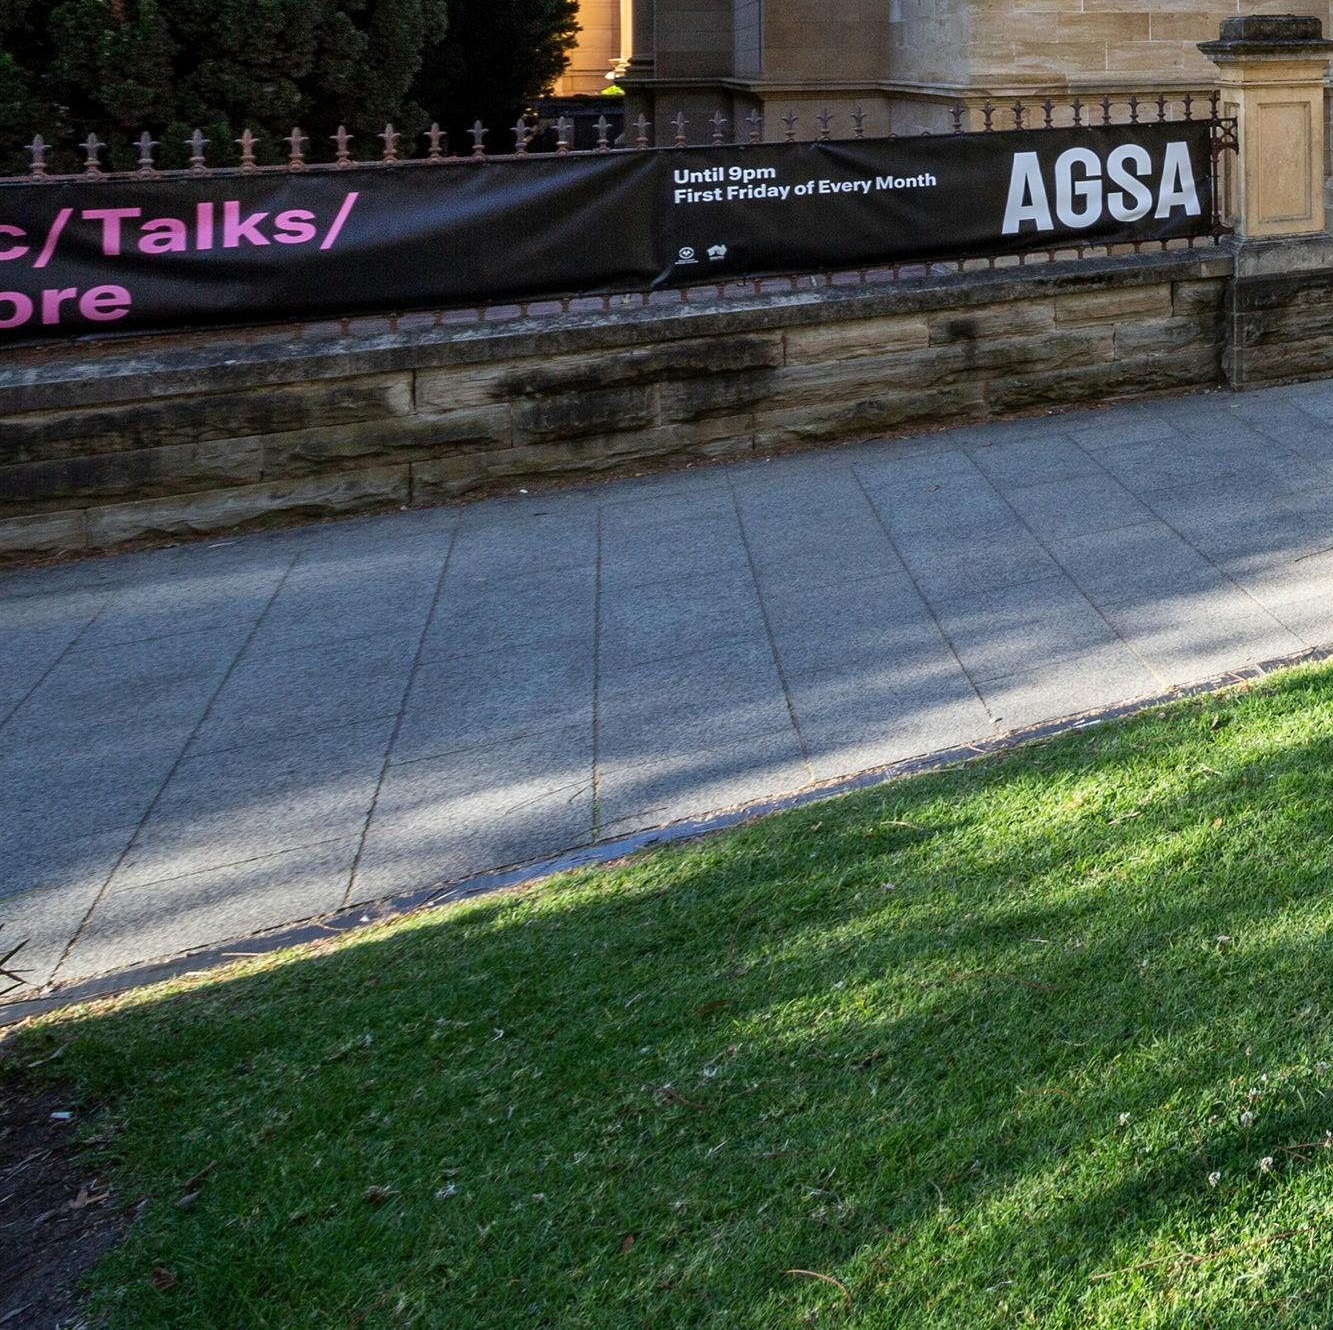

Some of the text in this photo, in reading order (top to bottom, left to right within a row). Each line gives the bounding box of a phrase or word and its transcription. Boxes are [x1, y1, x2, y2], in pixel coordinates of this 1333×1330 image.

[674, 165, 776, 184] Until 9pm
[674, 173, 937, 204] First Friday of Every Month
[1001, 141, 1201, 235] AGSA
